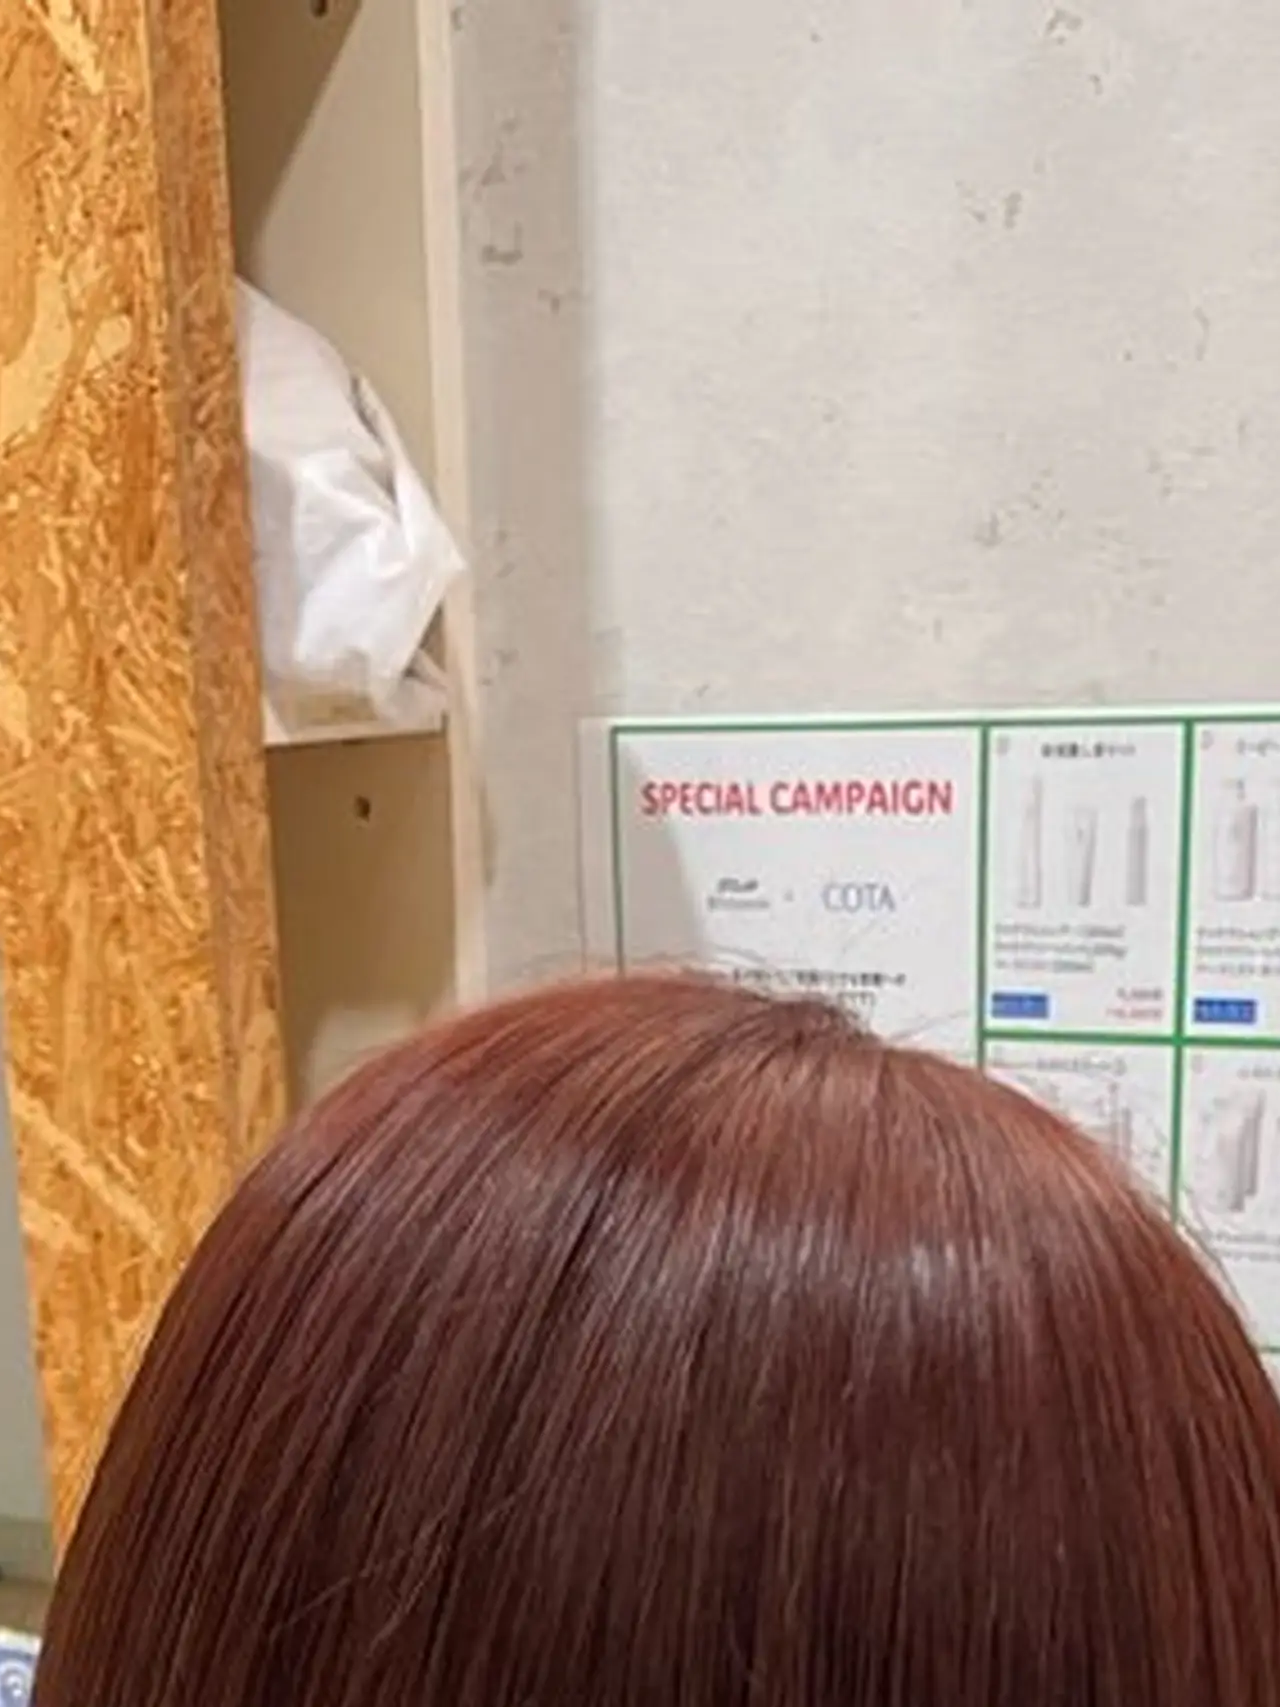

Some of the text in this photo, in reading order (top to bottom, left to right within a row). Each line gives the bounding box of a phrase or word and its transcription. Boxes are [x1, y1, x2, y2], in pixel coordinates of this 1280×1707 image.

[641, 779, 953, 815] SPECIAL CAMPAIGN
[822, 882, 897, 913] COTA
